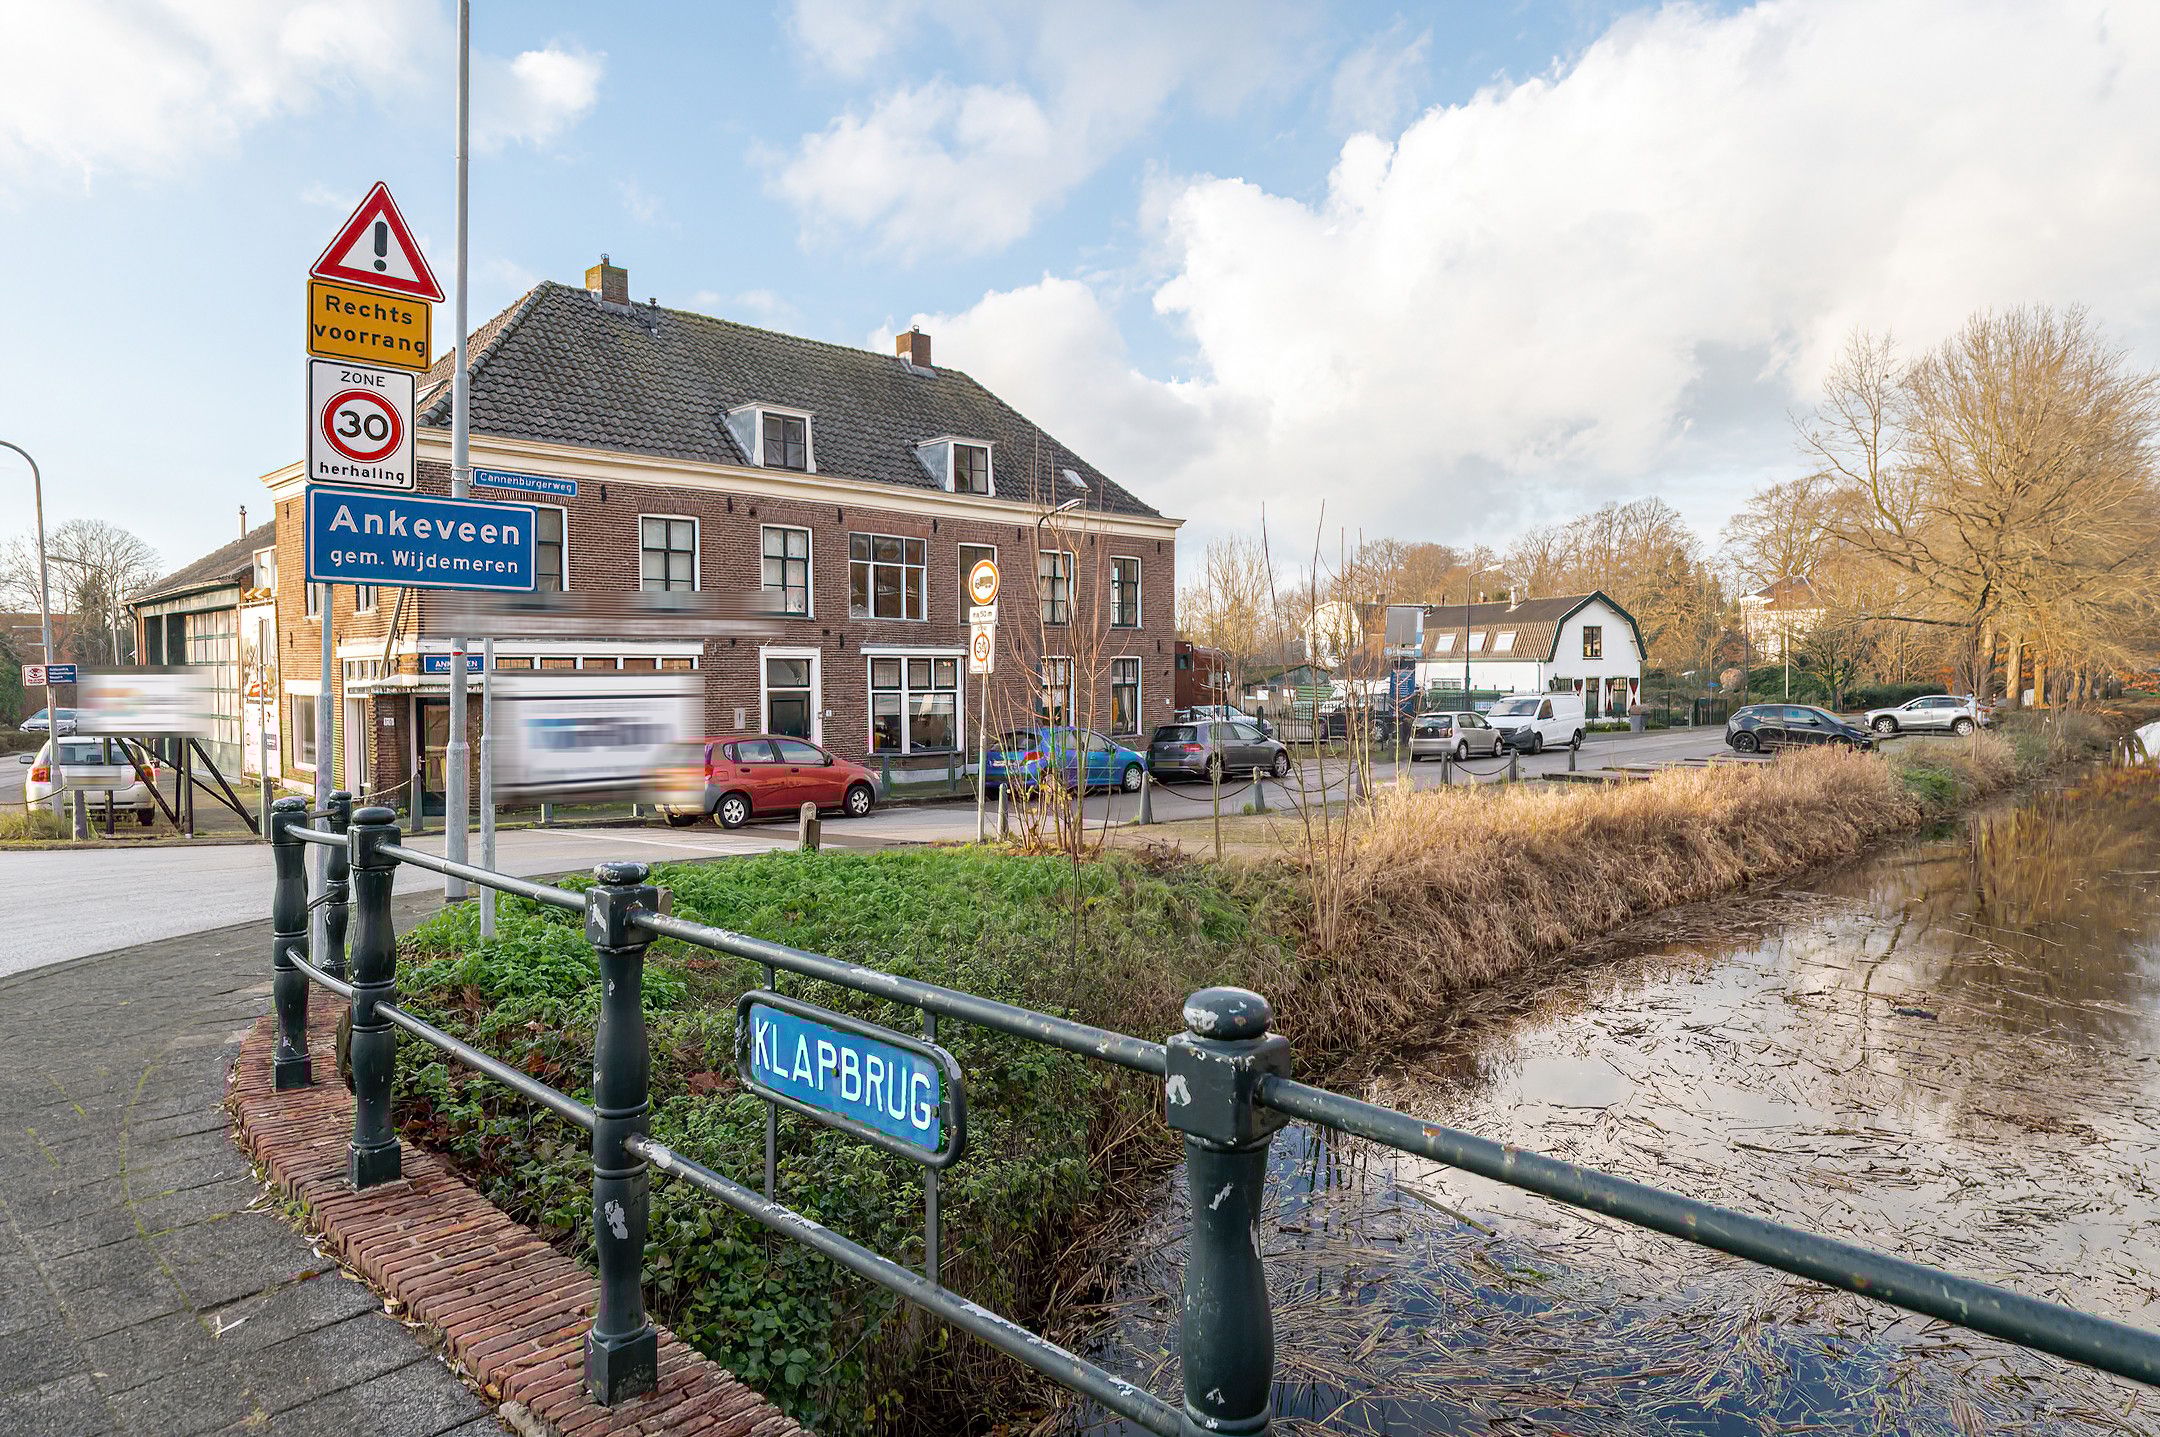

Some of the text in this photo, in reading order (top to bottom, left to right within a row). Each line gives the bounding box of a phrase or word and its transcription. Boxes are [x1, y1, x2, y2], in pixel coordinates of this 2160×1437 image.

[326, 294, 412, 325] Rechts
[314, 323, 425, 358] voorrang
[341, 370, 386, 388] ZONE
[337, 410, 389, 442] 30
[320, 462, 405, 484] herhaling
[480, 472, 572, 493] Cannenburgerweg
[329, 504, 521, 546] Ankeveen
[330, 549, 519, 574] gem. Wijdemeren
[755, 1017, 931, 1131] KLAPBRUG
